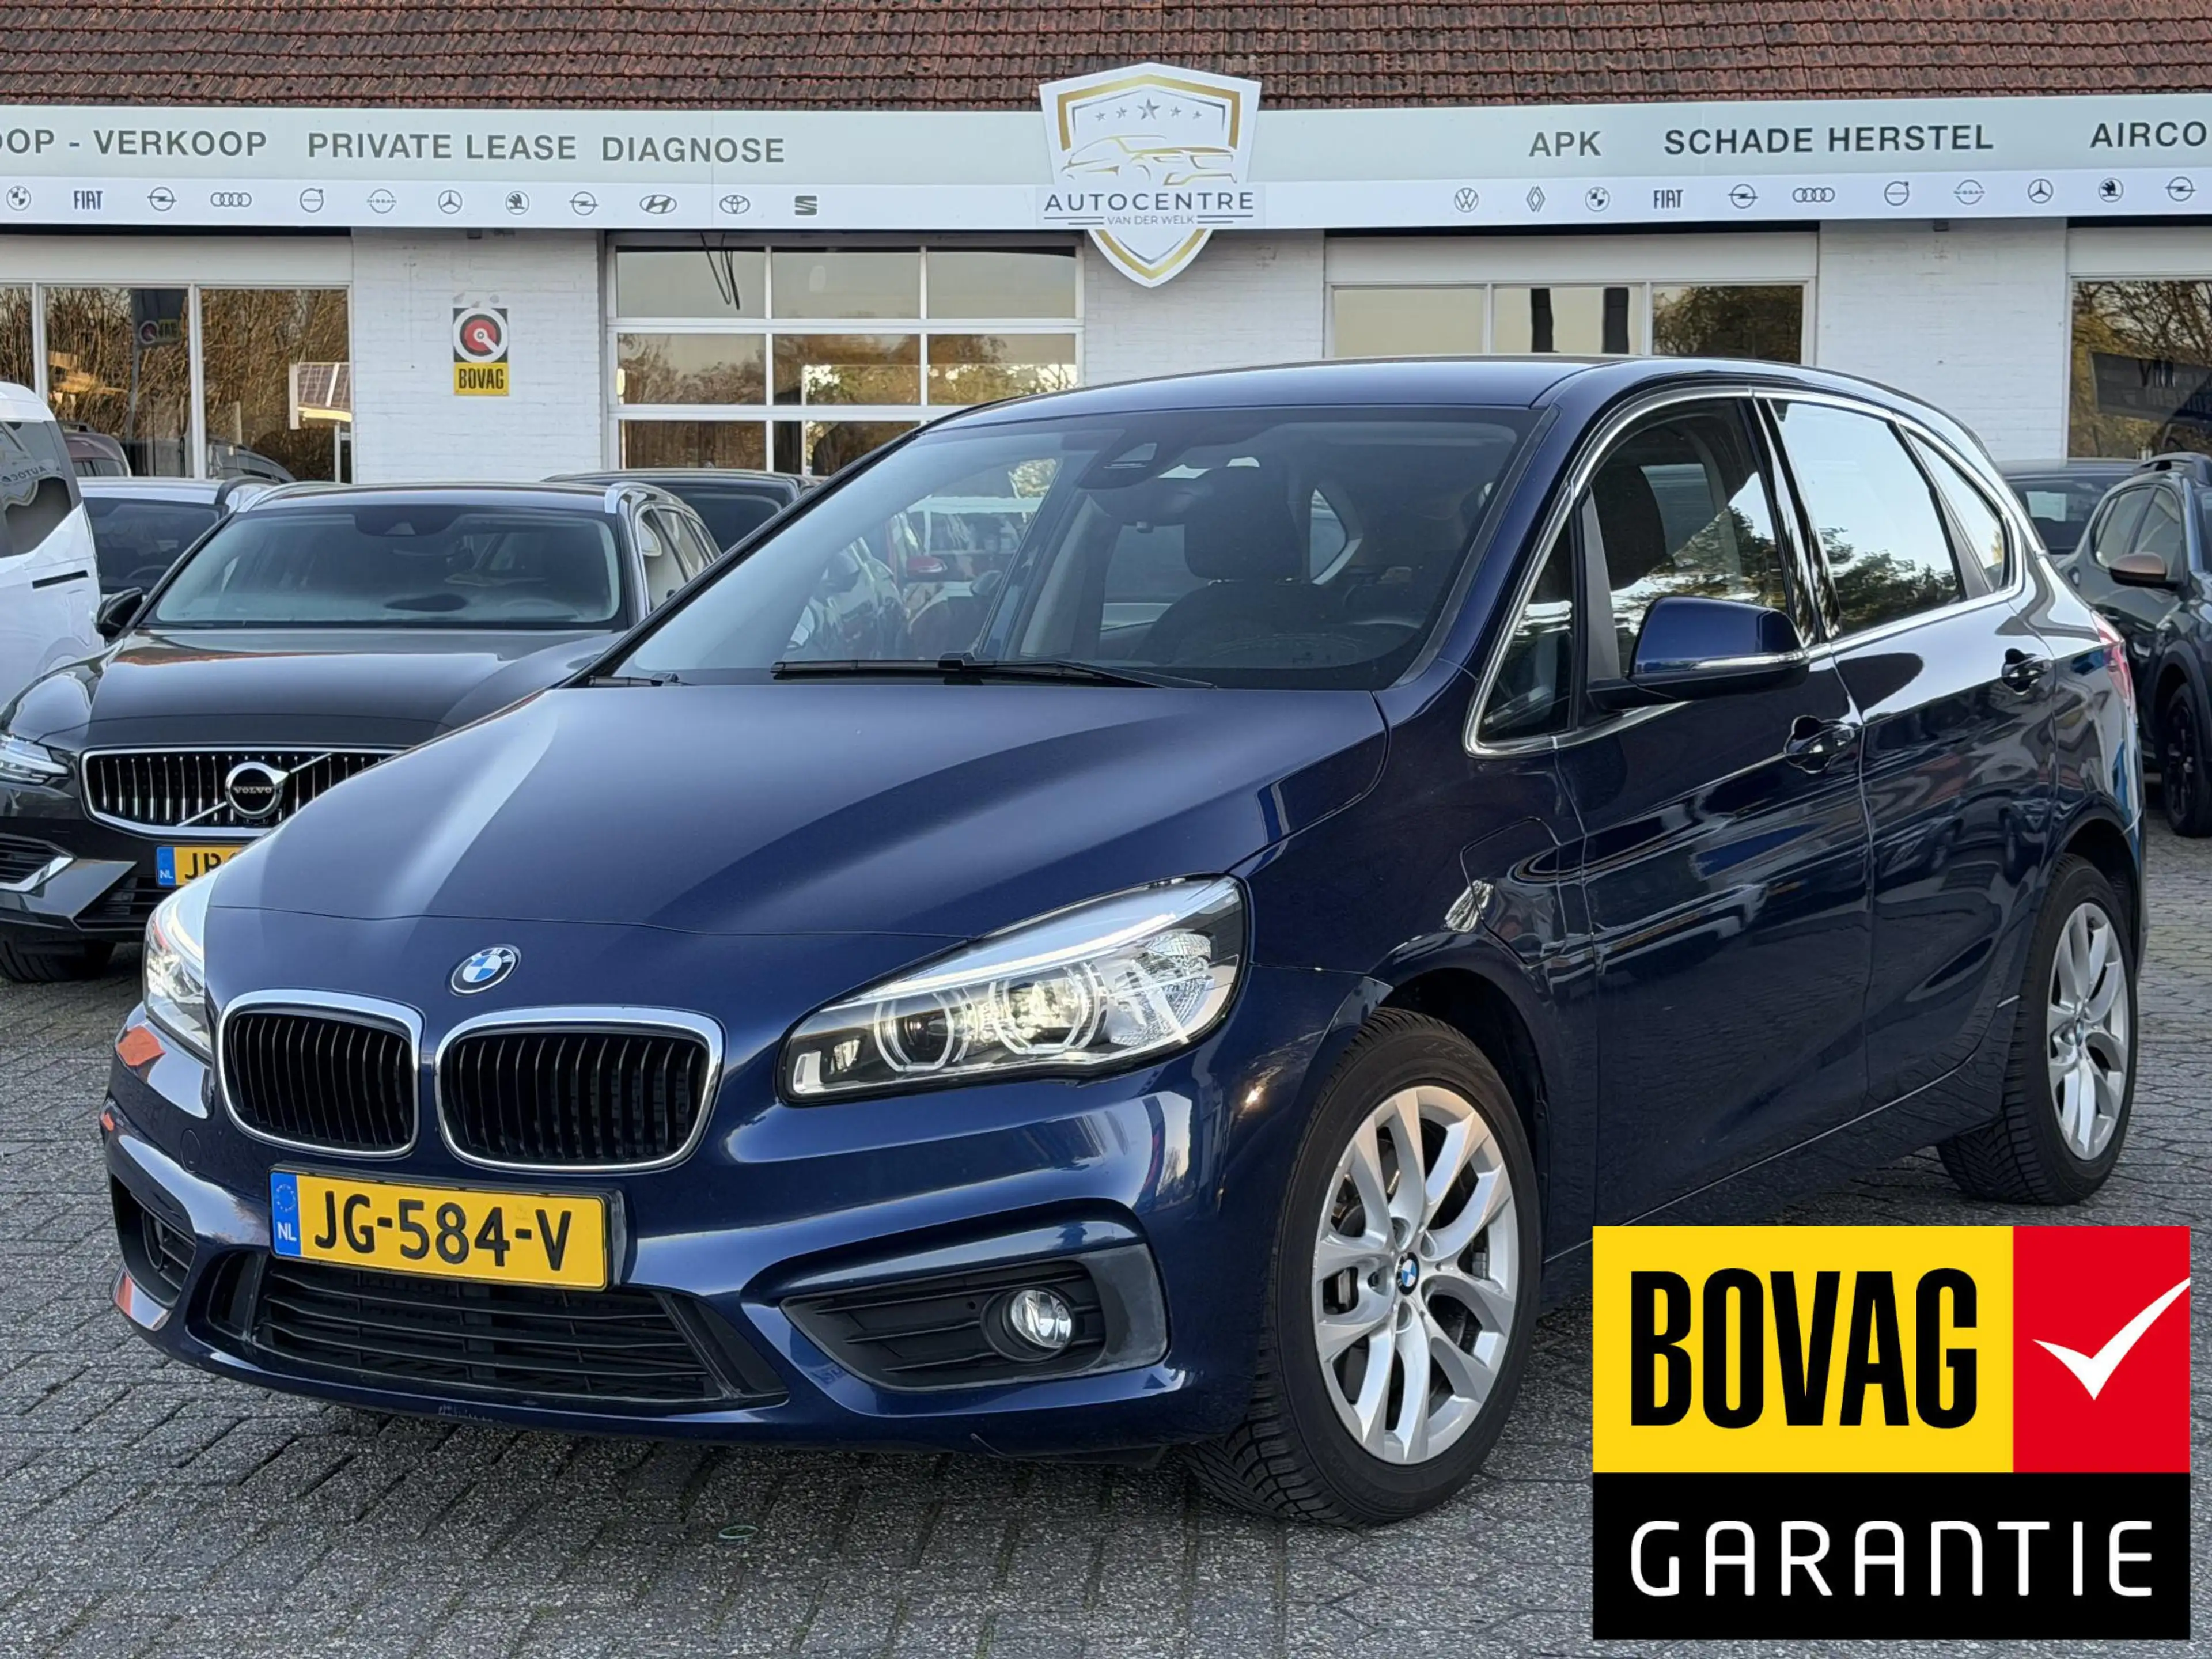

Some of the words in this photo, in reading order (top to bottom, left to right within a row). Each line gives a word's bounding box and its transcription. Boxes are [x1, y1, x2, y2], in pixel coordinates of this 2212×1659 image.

[0, 129, 54, 154] OP
[93, 130, 266, 156] VERKOOP
[1529, 131, 1601, 157] APK
[1665, 128, 1813, 155] SCHADE
[1829, 125, 1994, 151] HERSTEL
[2090, 122, 2207, 148] AIRCO
[309, 133, 452, 159] PRIVATE
[467, 135, 576, 160] LEASE
[603, 137, 784, 163] DIAGNOSE
[73, 190, 103, 210] FIAT
[1044, 192, 1254, 211] AUTOCENTRE
[1653, 189, 1684, 209] FIAT
[1107, 216, 1131, 225] VAN
[1134, 215, 1158, 225] DER
[1161, 215, 1194, 225] WELK
[459, 368, 504, 389] BOVAG
[233, 786, 272, 794] VOLVO
[160, 869, 173, 879] NL
[277, 1221, 297, 1242] NL
[315, 1191, 571, 1271] JG-584-V
